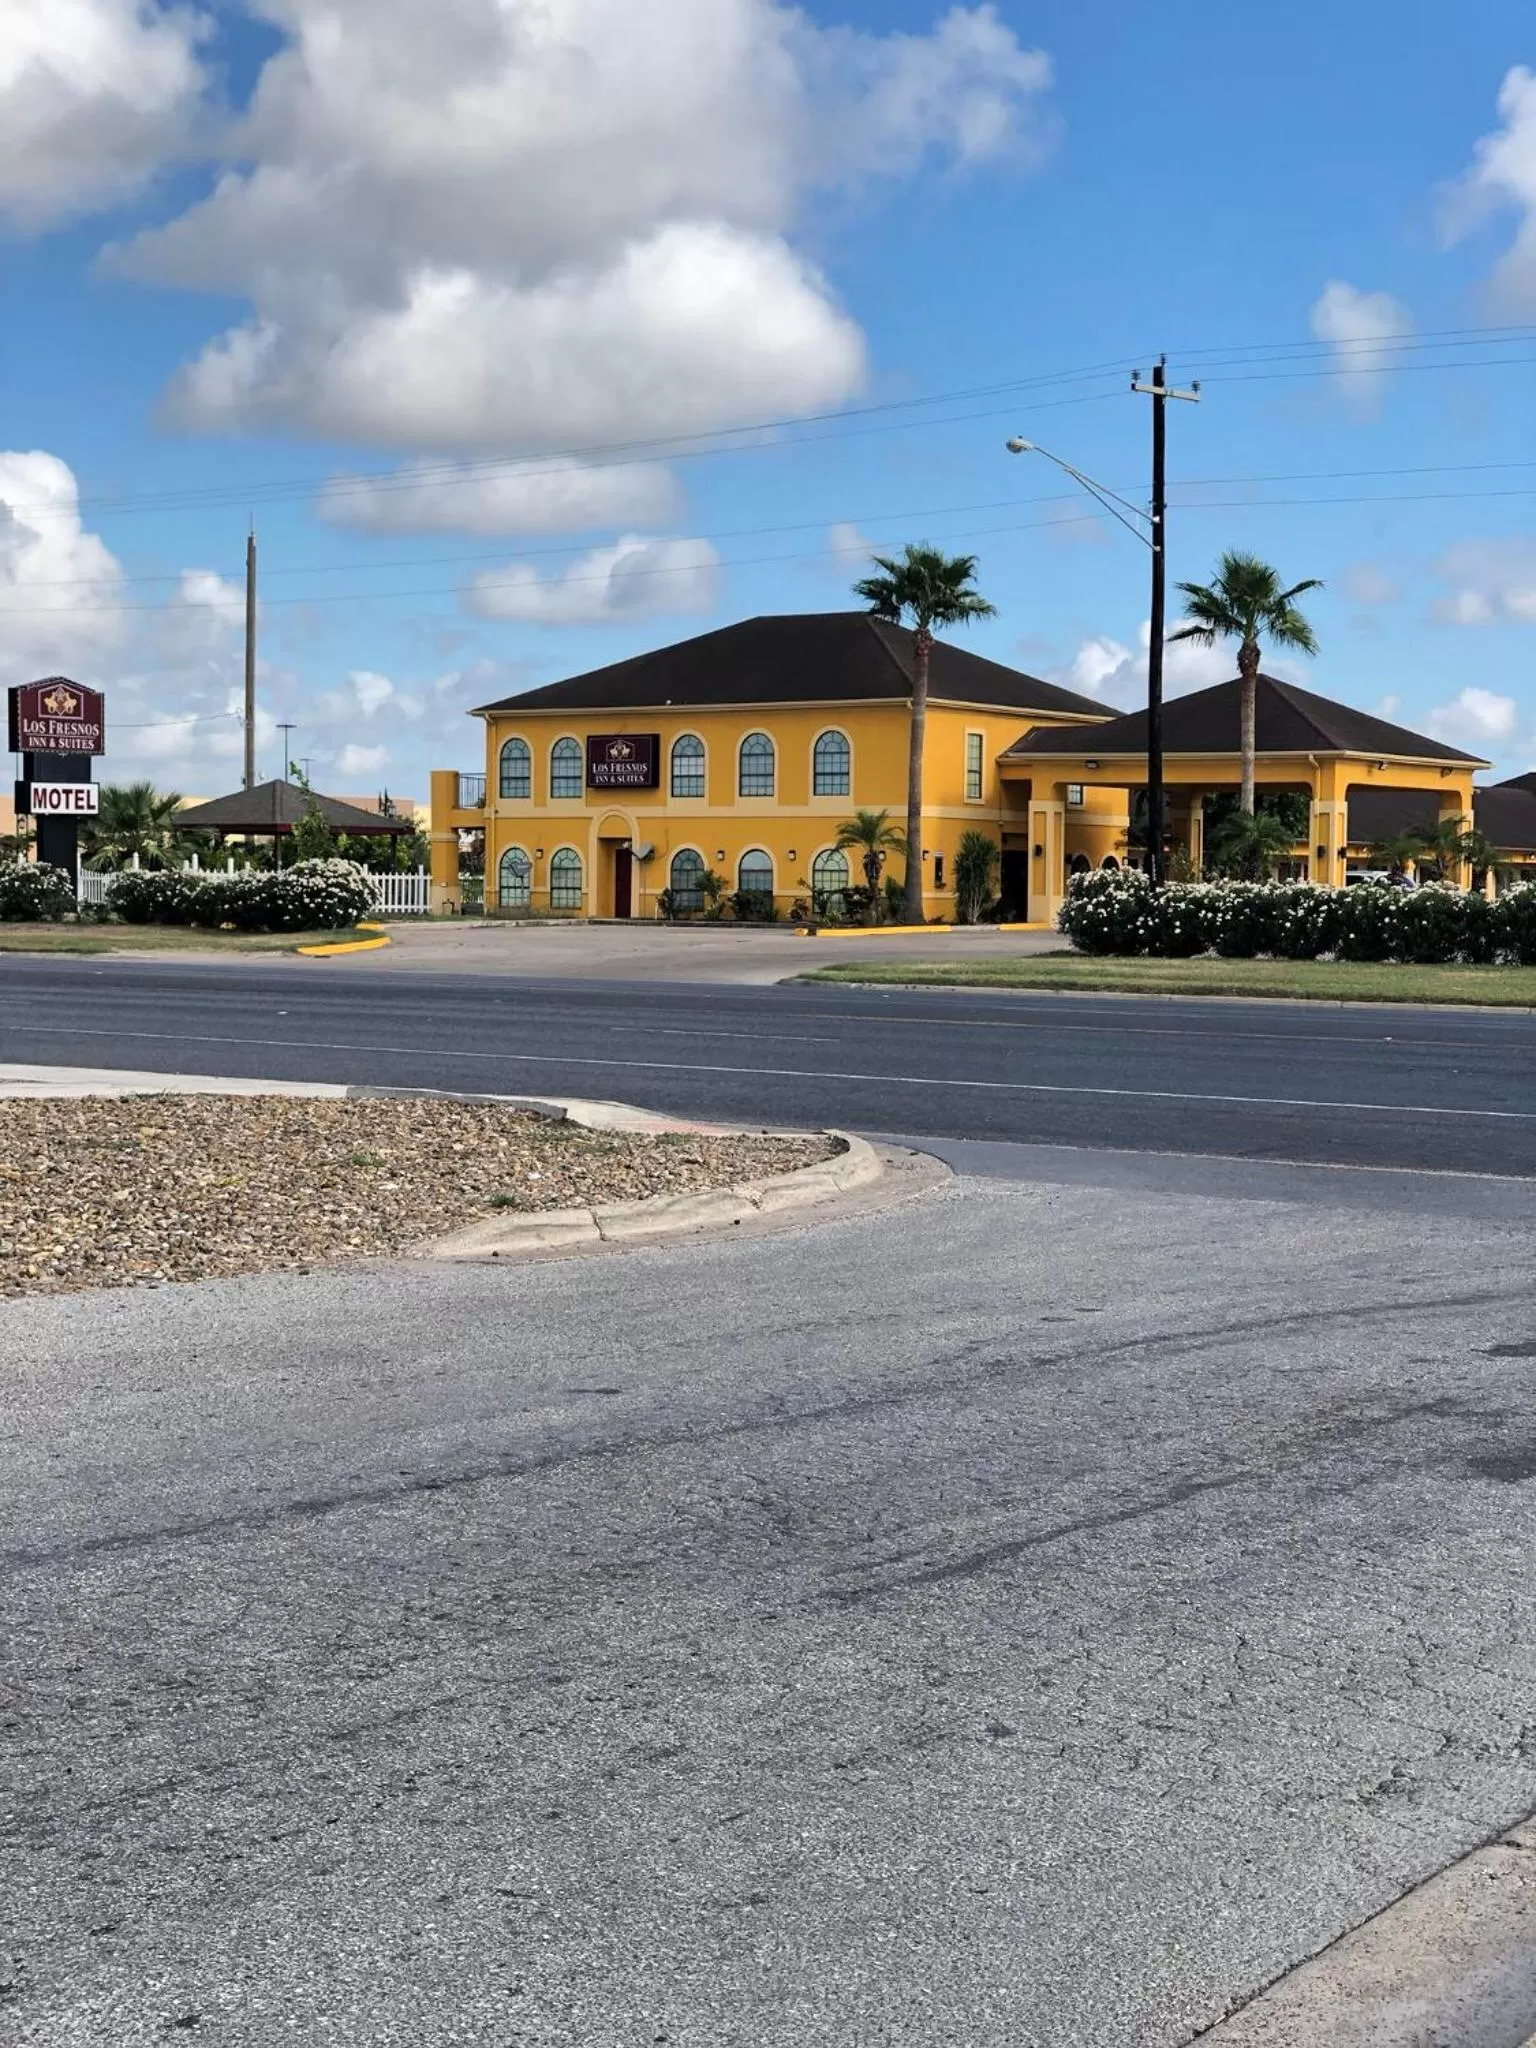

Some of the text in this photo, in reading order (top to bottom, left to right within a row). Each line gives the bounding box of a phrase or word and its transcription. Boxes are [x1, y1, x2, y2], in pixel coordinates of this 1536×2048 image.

[23, 718, 100, 737] LOS FRESNOS
[28, 737, 94, 749] INN & SUITES
[593, 763, 609, 773] LOS
[33, 788, 96, 810] MOTEL
